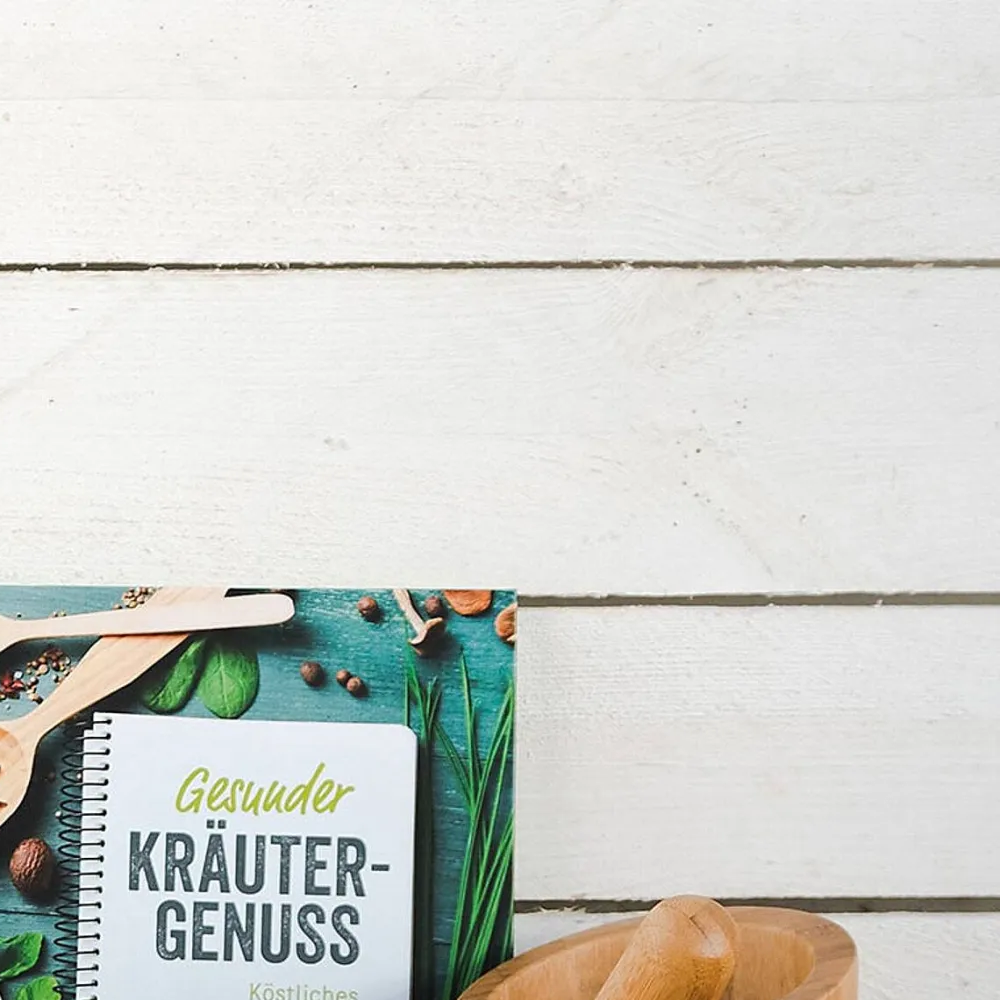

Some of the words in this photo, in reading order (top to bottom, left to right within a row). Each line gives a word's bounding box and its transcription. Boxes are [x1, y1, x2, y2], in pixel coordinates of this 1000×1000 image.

[175, 762, 355, 815] Gesunder
[128, 819, 390, 897] KRÄUTER-
[156, 900, 360, 965] GENUSS
